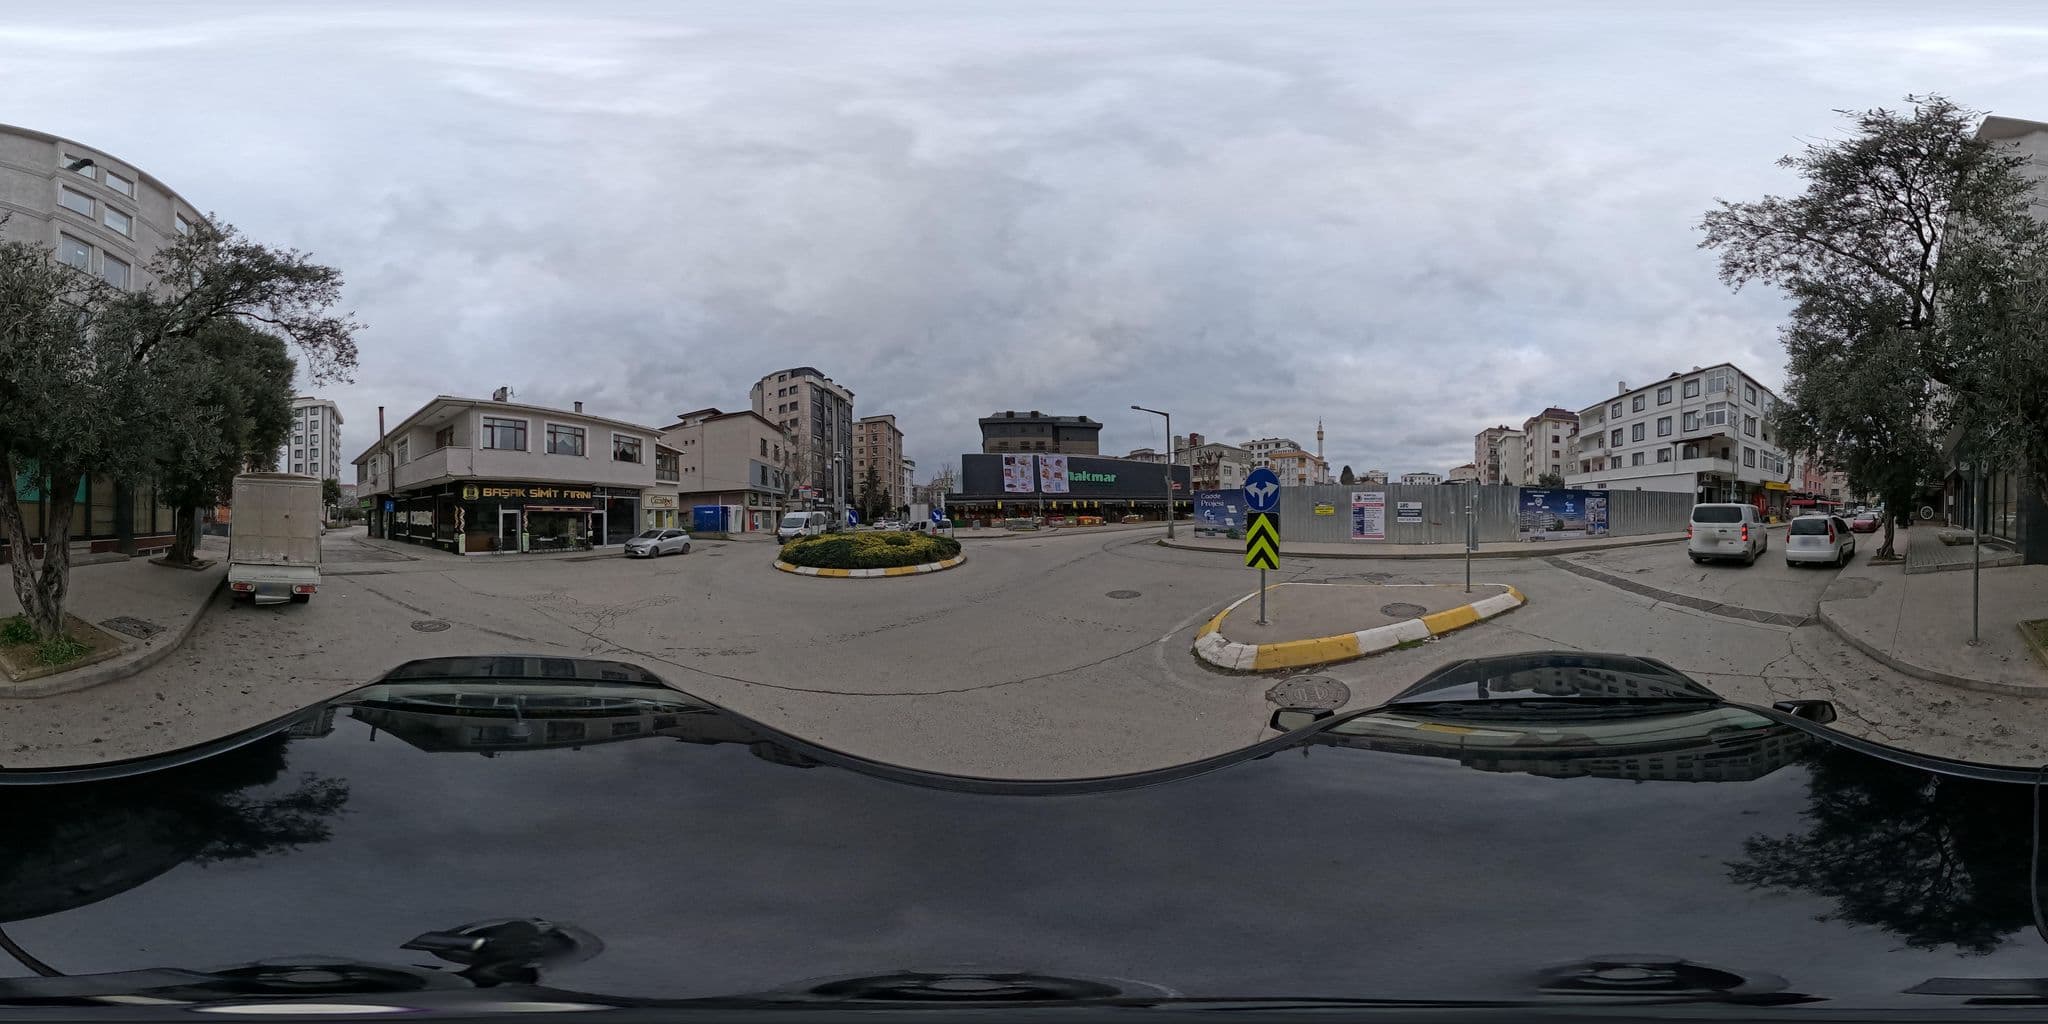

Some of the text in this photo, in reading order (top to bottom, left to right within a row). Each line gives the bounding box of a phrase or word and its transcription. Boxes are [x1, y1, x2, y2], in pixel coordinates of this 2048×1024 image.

[483, 487, 591, 499] BAŞAK SİMİT FIRINI
